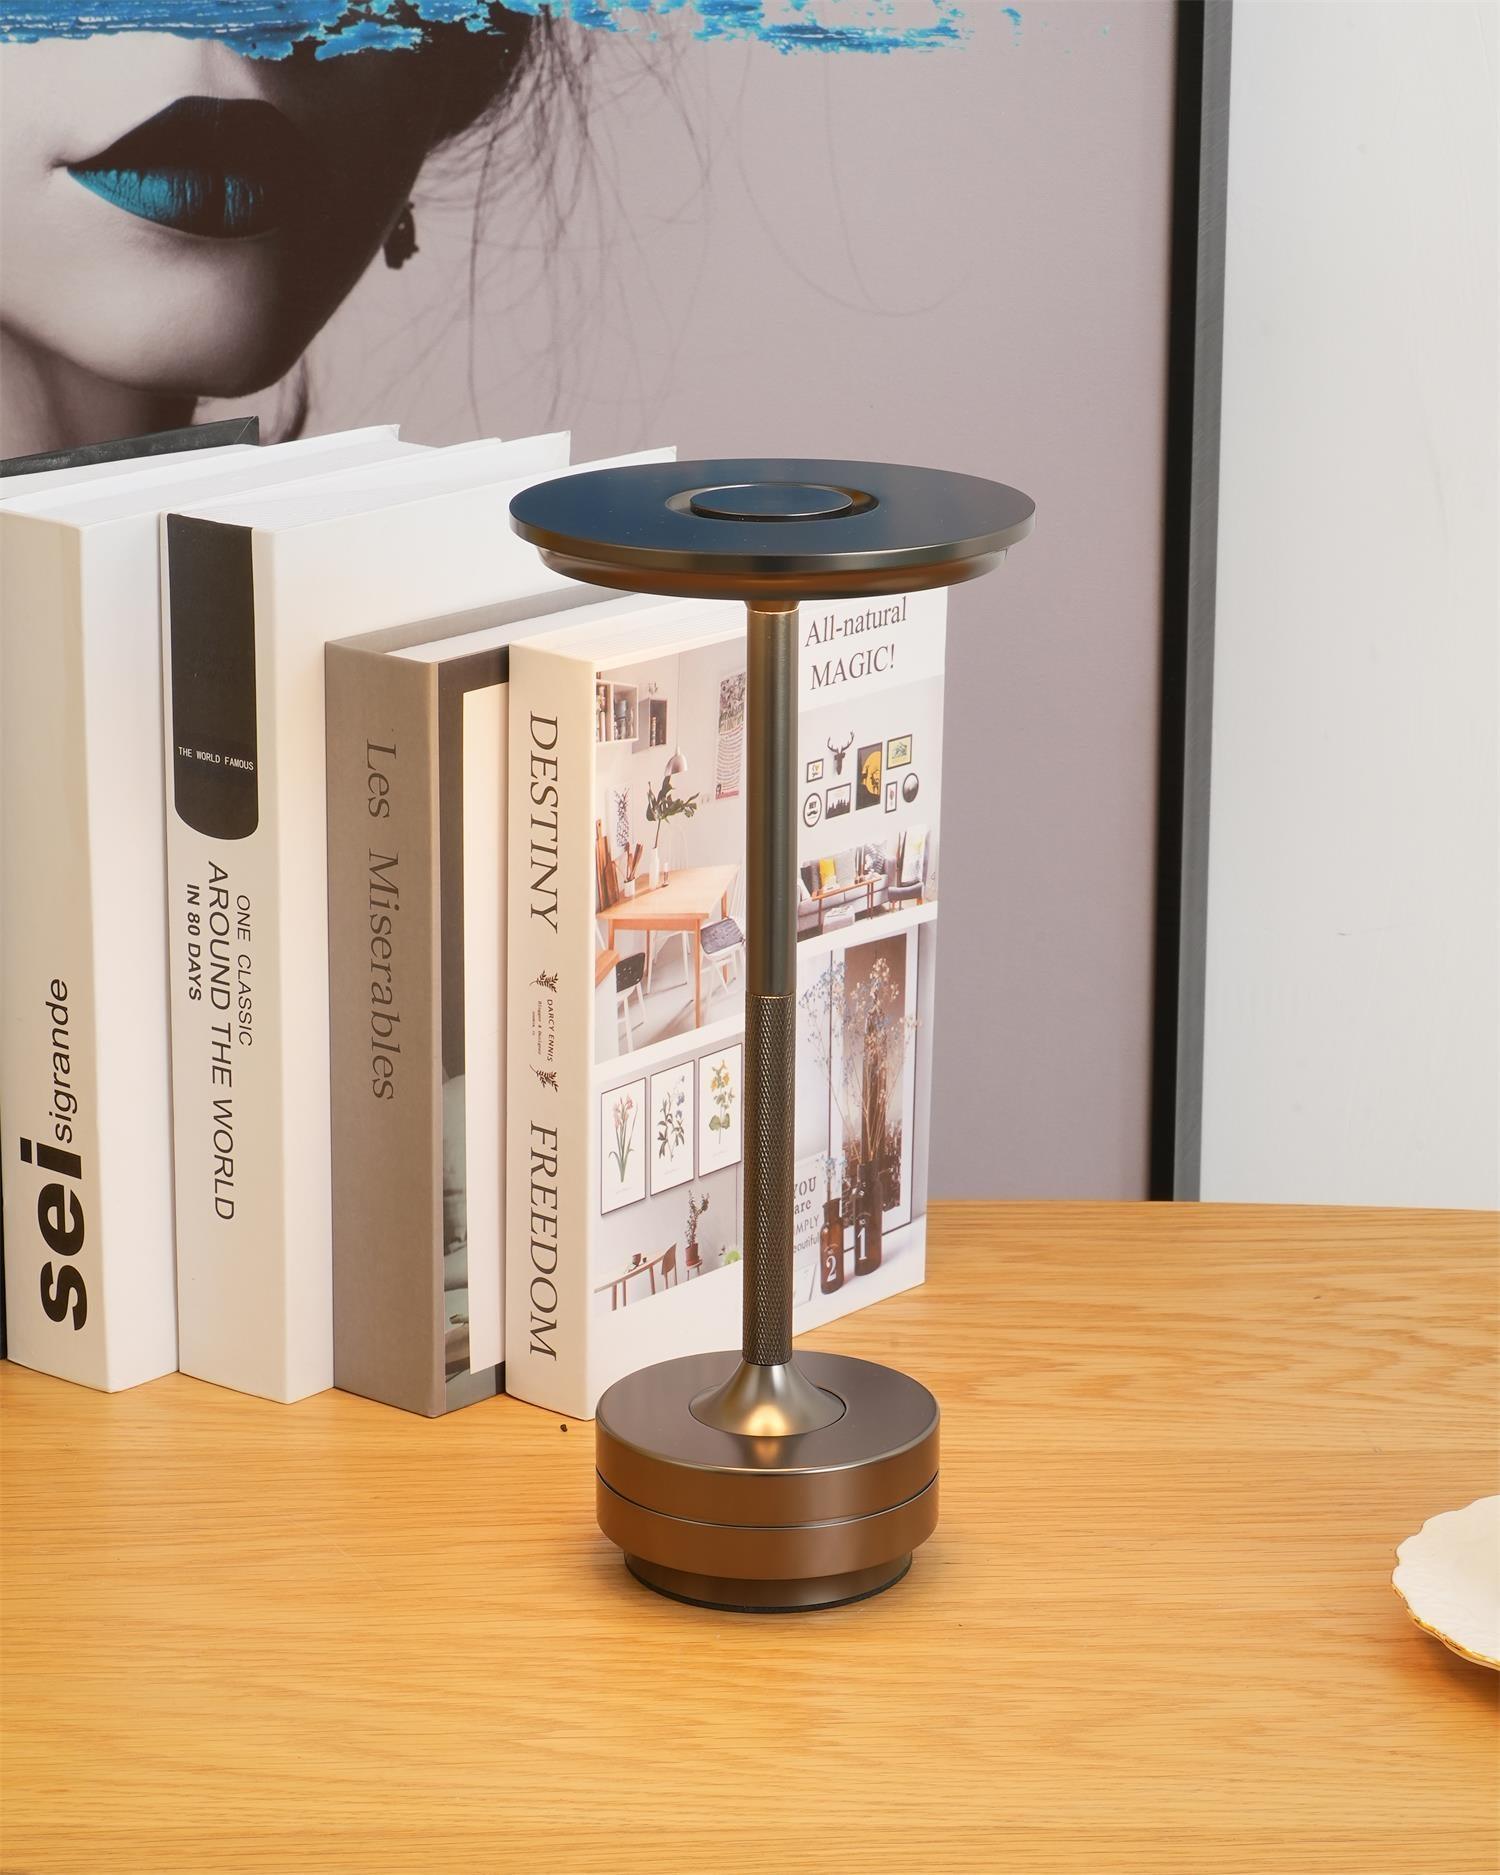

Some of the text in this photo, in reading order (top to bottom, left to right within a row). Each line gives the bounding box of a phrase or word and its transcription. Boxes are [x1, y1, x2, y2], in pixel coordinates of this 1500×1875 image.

[805, 596, 907, 647] All-natural
[809, 644, 895, 690] MAGIC!
[178, 746, 254, 771] THE WORLD FAMOUS
[529, 710, 559, 935] DESTINY
[186, 883, 202, 1001] IN 80 DAYS
[366, 738, 400, 1101] Les Miserables
[236, 894, 253, 1047] ONE CLASSIC
[208, 860, 236, 1221] AROUND THE WORLD
[546, 998, 555, 1063] DARCY ENNIS
[529, 1119, 559, 1362] FREEDOM
[795, 1215, 820, 1236] MPLY
[857, 1226, 868, 1261] 1
[826, 1255, 837, 1282] 2
